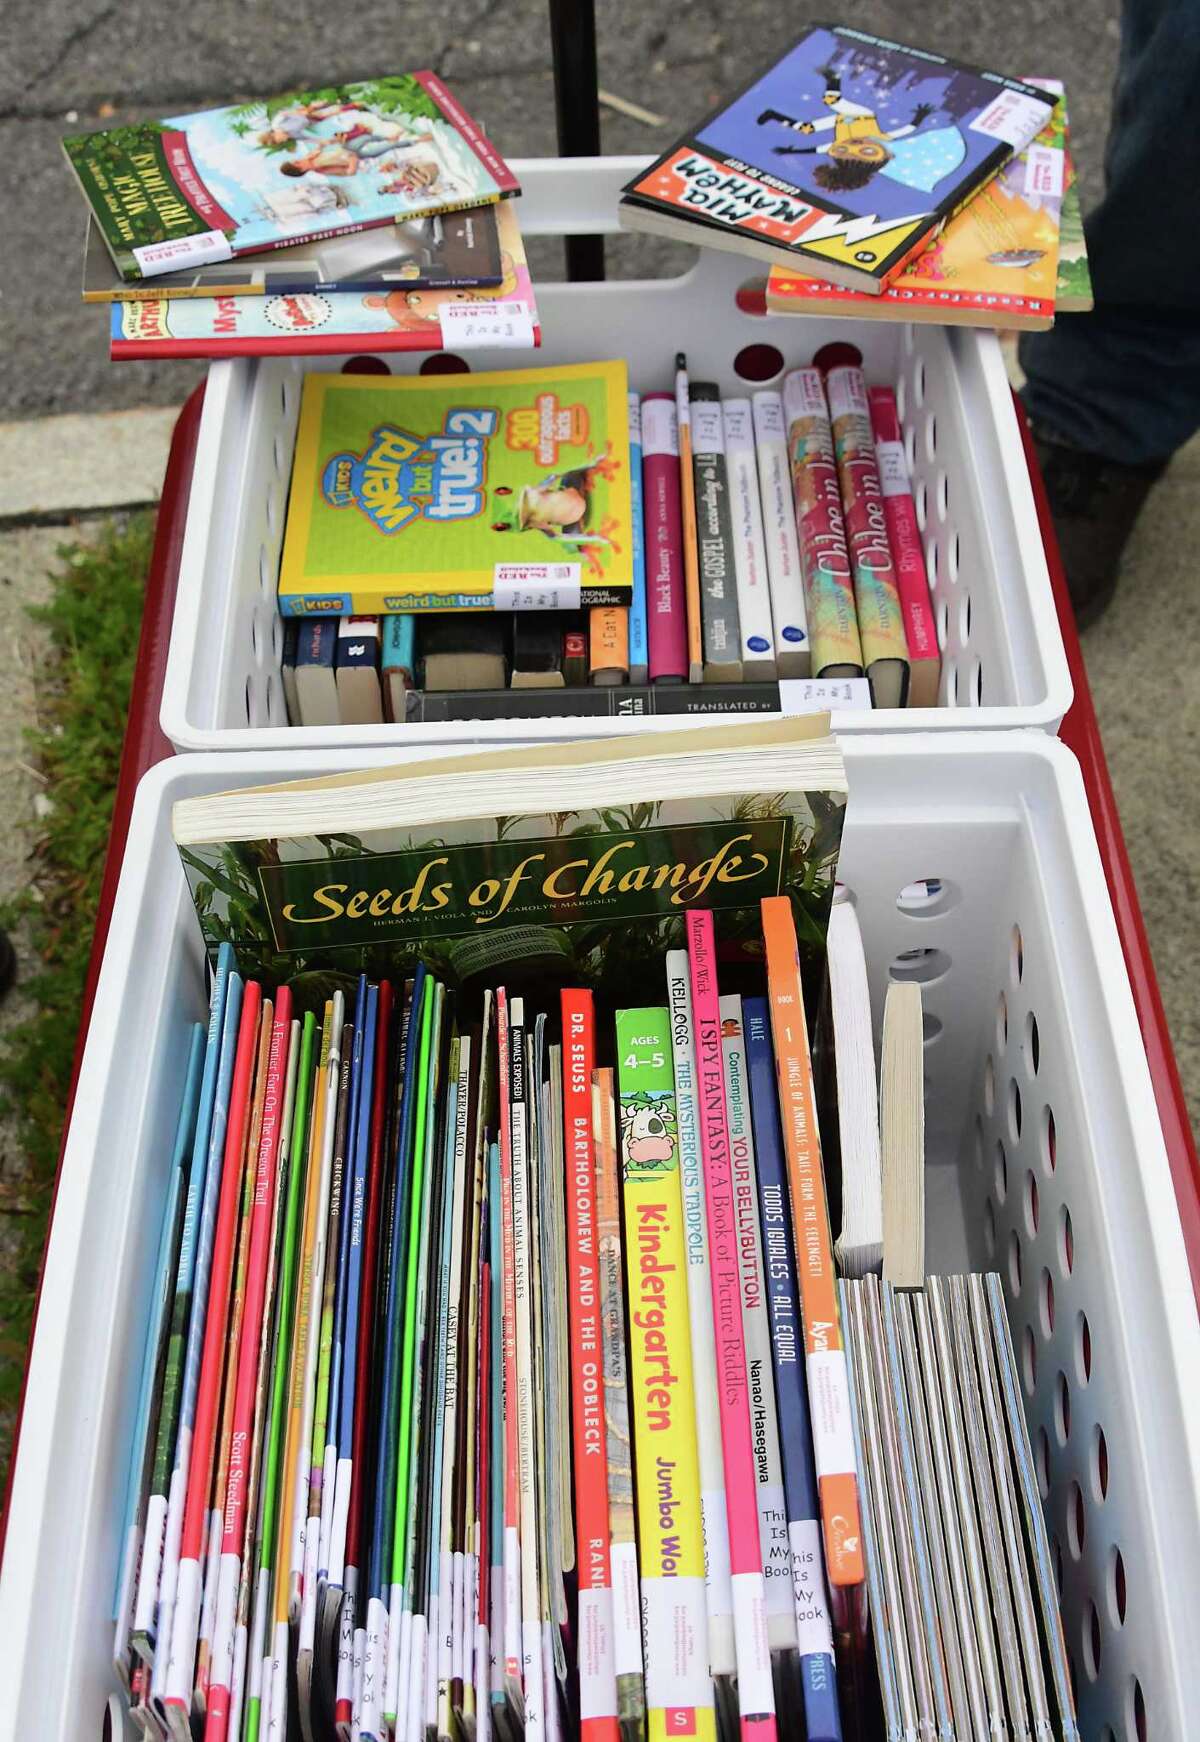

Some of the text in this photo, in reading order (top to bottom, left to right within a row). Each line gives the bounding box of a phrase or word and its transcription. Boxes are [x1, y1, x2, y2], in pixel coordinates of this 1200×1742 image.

[114, 174, 149, 216] MAGIC
[115, 216, 135, 241] MARY
[275, 225, 363, 249] PIRATES PAST NOON
[140, 300, 162, 337] ARTHU
[511, 410, 539, 448] 300
[336, 461, 352, 492] KIDS
[361, 430, 421, 530] weird
[410, 465, 433, 493] but
[429, 411, 494, 518] true! 2
[817, 477, 840, 502] in
[856, 473, 881, 498] in
[701, 469, 726, 599] the GOSPEL according to
[815, 507, 851, 577] Chloe
[855, 503, 892, 572] Chloe
[897, 518, 917, 572] Rhymes
[656, 548, 673, 613] Black Beauty
[306, 600, 343, 611] KIDS
[385, 594, 456, 609] weird but
[603, 621, 616, 638] Cat
[912, 602, 930, 652] HUMPHREY
[687, 703, 756, 711] TRANSLATED
[282, 833, 769, 924] Seeds of Change
[373, 916, 420, 927] HERMAN
[435, 912, 466, 921] VIOLA
[506, 903, 556, 913] CAROLYN
[561, 897, 617, 909] MARGOLIS
[692, 917, 711, 995] Marzollo/Wick
[671, 977, 689, 1046] KELLOGG
[750, 1017, 765, 1041] HALE
[270, 1032, 282, 1070] Frontier
[571, 1013, 586, 1094] DR. SEUSS
[630, 1035, 660, 1046] AGES
[701, 1031, 719, 1069] SPY
[785, 1027, 792, 1043] 1
[268, 1072, 278, 1093] Fort
[340, 1060, 349, 1089] CANNON
[513, 1029, 524, 1100] ANIMALS EXPOSED!
[266, 1096, 275, 1112] On
[455, 1070, 467, 1156] THAYER/POLACCO
[704, 1074, 728, 1171] FANTASY:
[262, 1116, 274, 1134] The
[259, 1137, 272, 1176] Oregon
[514, 1132, 523, 1164] TRUTH
[676, 1060, 704, 1266] THE MYSTERIOUS TADPOLE
[787, 1057, 823, 1277] JUNGLE OF TAILS FORM THE SERENGETI
[256, 1178, 268, 1205] Trail
[330, 1157, 342, 1216] CRICKWING
[515, 1167, 524, 1204] ABOUT
[711, 1176, 728, 1189] A
[728, 1051, 761, 1309] Contemplating YOUR BELLYBUTTON
[351, 1177, 364, 1246] Since We're Friends
[712, 1194, 731, 1240] Book
[515, 1211, 525, 1252] ANIMAL
[606, 1248, 617, 1285] DANCE
[716, 1243, 733, 1262] of
[517, 1257, 527, 1299] SENSES
[574, 1117, 601, 1456] BARTHOLOMEW AND THE OOBLECK
[764, 1184, 797, 1366] TODOS IGUALES ALL EQUAL
[717, 1271, 739, 1333] Picture
[444, 1306, 457, 1409] CASEY AT THE BAT
[608, 1308, 622, 1378] GRANDPA'S
[633, 1203, 682, 1530] Kindergarten Jumbo
[723, 1338, 743, 1406] Riddles
[519, 1377, 529, 1493] STONEHOUSE/BERTRAM
[750, 1360, 770, 1483] Nanao/Hasegawa
[224, 1431, 247, 1534] Scott Steedman
[763, 1511, 785, 1523] Thi
[770, 1527, 786, 1540] Is
[764, 1565, 792, 1578] Boo
[769, 1547, 789, 1560] My
[798, 1608, 823, 1621] ook
[674, 1712, 688, 1727] S
